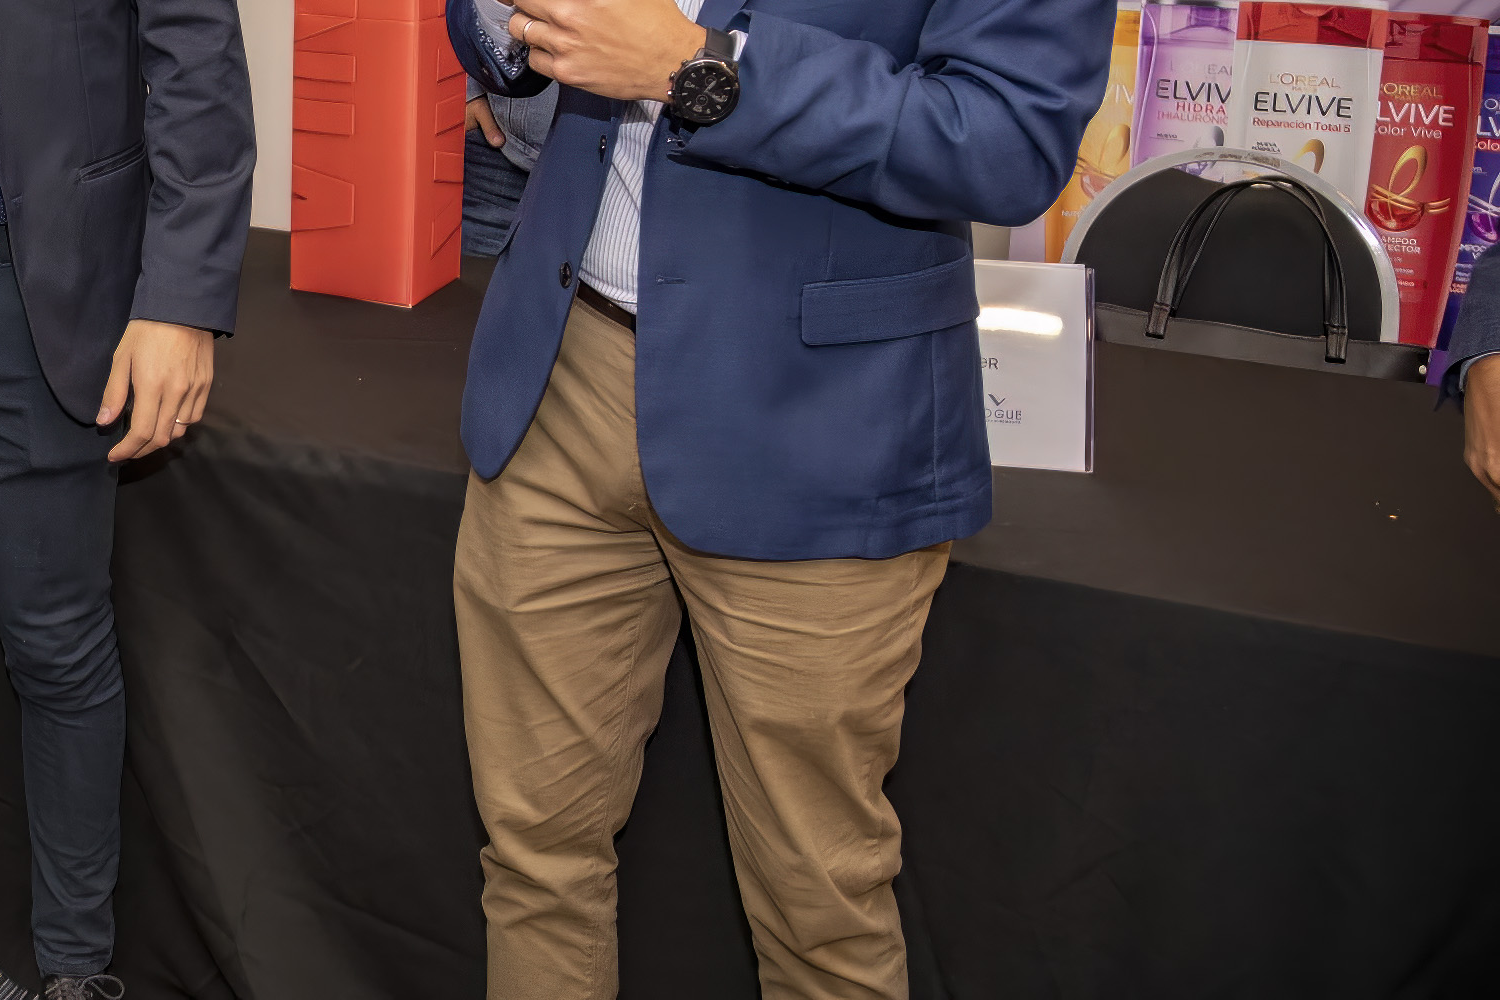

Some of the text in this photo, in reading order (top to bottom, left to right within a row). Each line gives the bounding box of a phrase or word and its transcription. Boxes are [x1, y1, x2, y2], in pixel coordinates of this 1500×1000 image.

[1155, 79, 1232, 104] ELVIV
[1253, 91, 1353, 119] ELVIVE
[1376, 100, 1455, 127] LVIVE
[1315, 121, 1341, 132] Total
